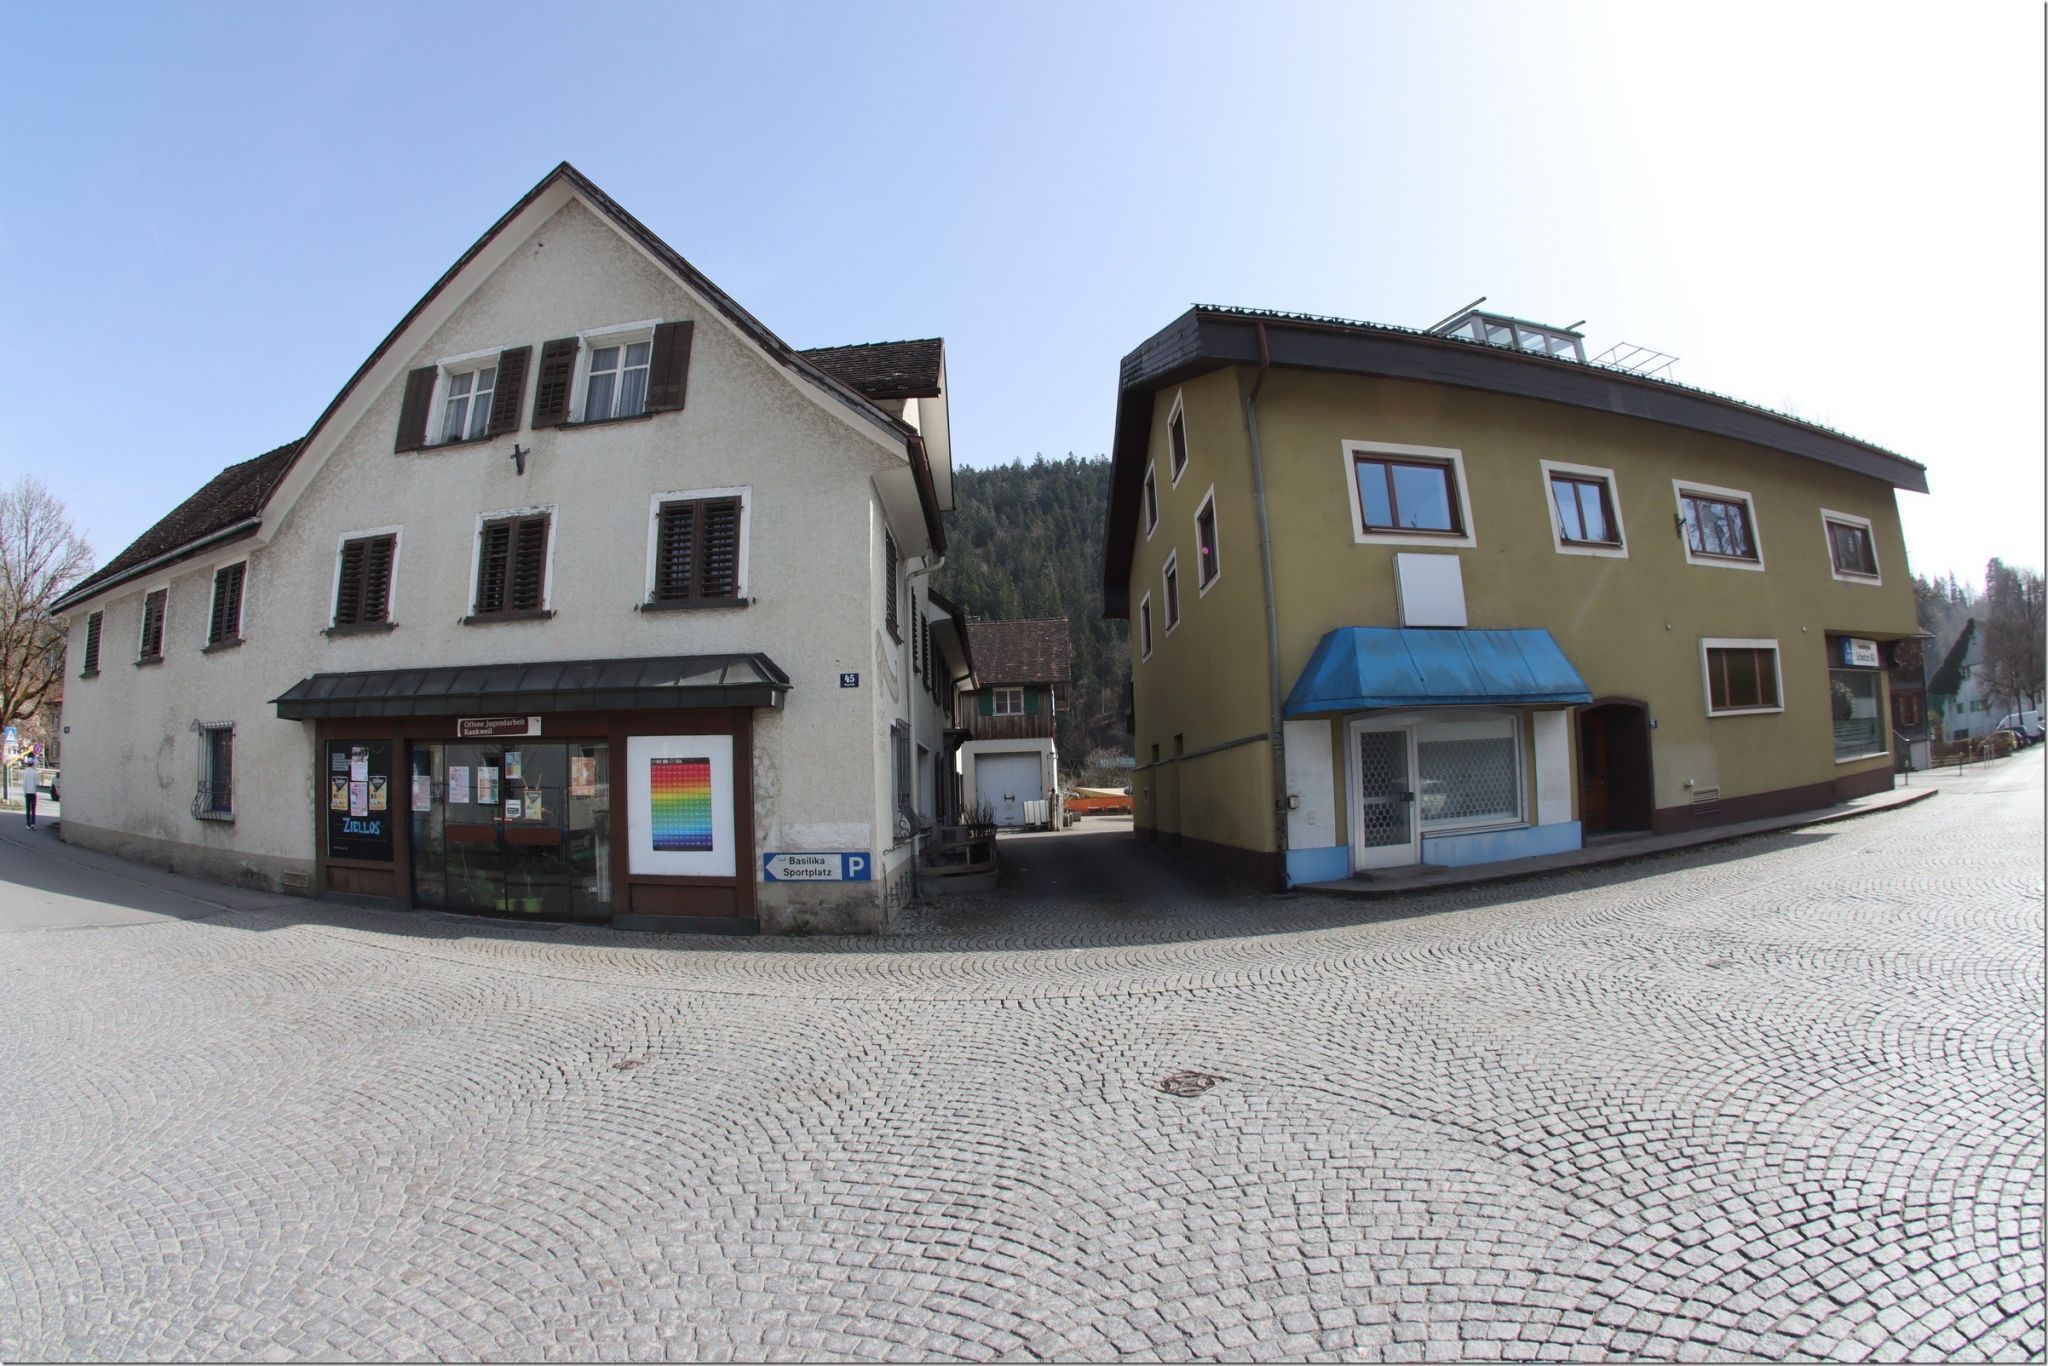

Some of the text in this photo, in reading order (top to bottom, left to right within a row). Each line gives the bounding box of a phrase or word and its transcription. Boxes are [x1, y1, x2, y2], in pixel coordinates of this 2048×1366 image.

[844, 674, 855, 683] 45
[463, 719, 525, 728] Offene Jugendarbeit
[343, 817, 381, 835] ZIELLOS
[789, 856, 826, 865] Basilika
[848, 856, 865, 877] P
[783, 867, 832, 878] Sportplatz
